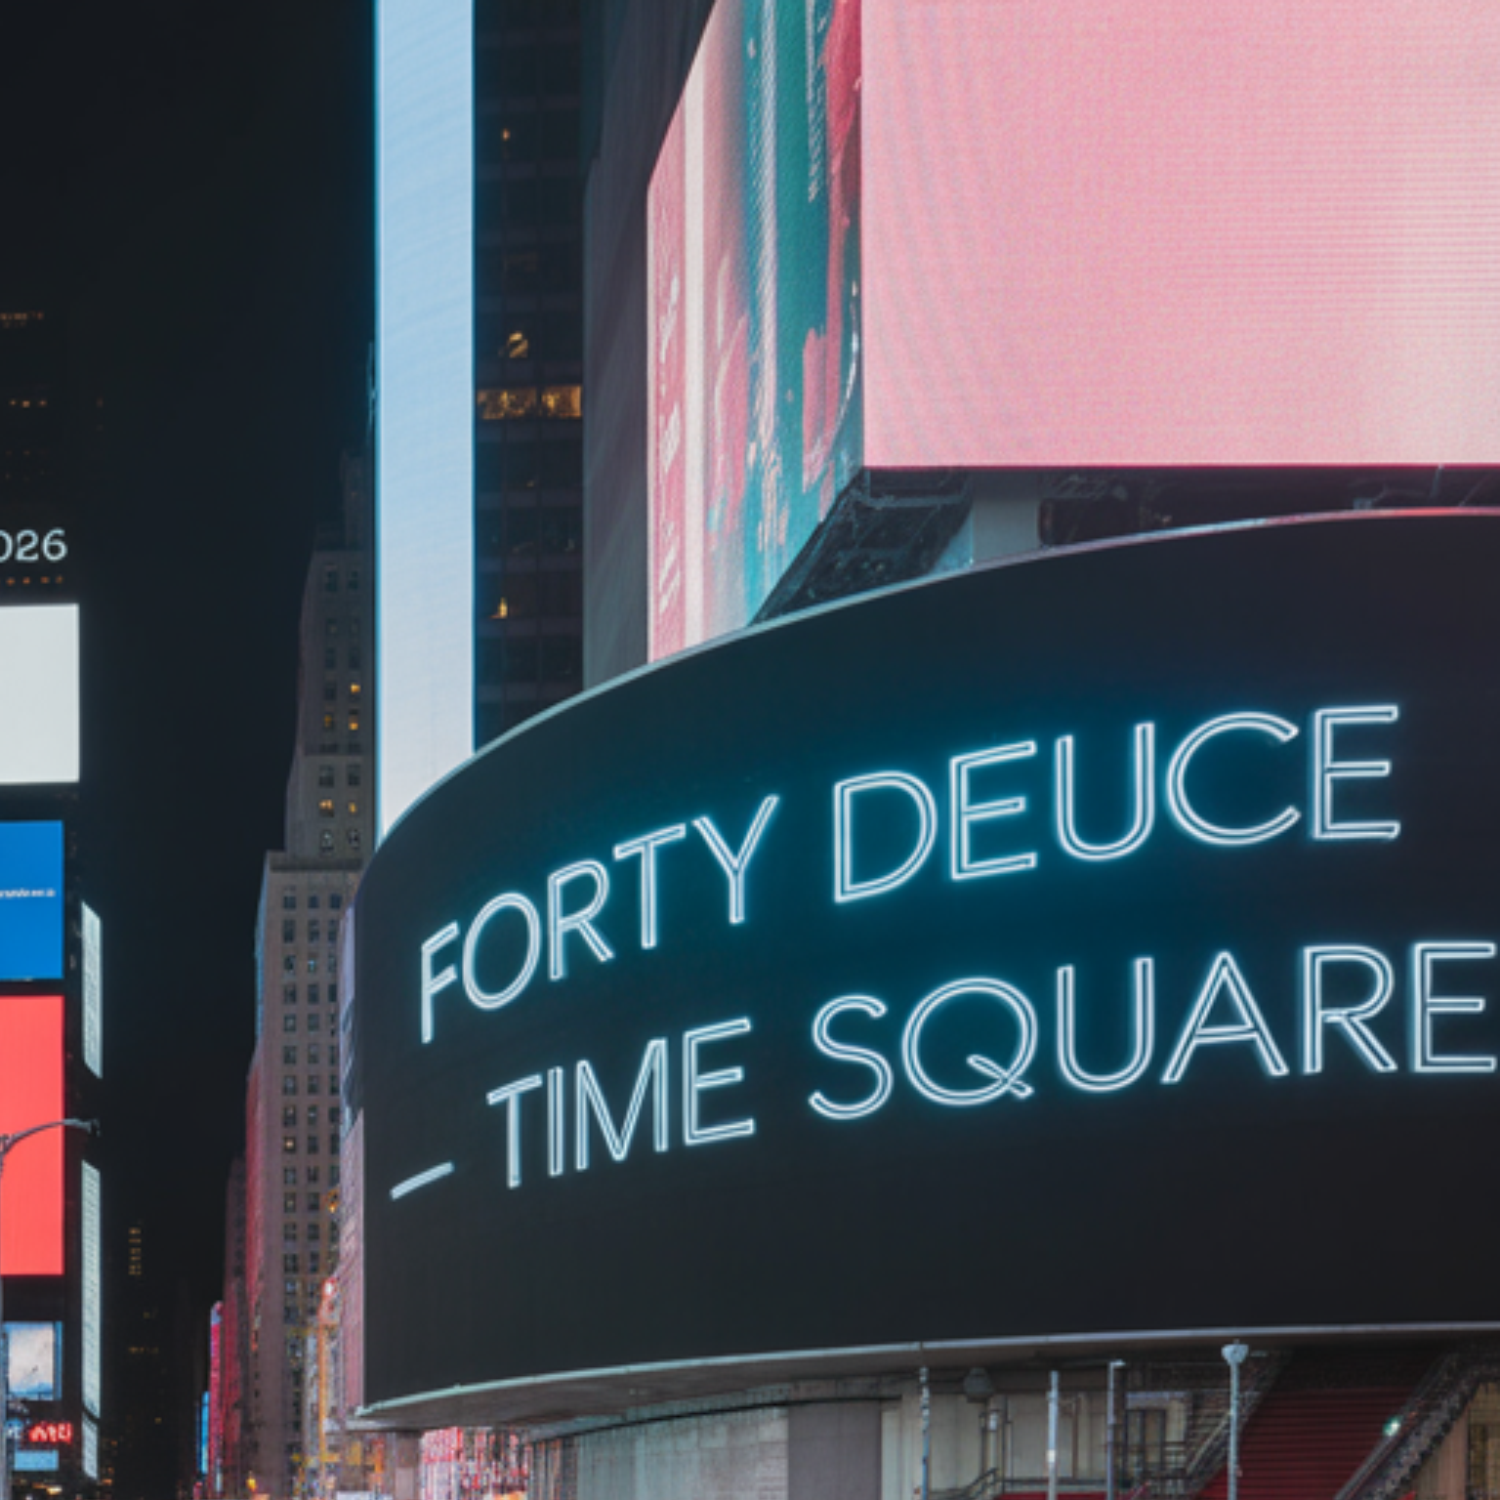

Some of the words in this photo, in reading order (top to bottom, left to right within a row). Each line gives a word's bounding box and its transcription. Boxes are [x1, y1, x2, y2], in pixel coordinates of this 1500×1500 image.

[420, 794, 781, 1045] FORTY
[833, 704, 1401, 904] DEUCE
[485, 1016, 756, 1190] TIME
[807, 941, 1498, 1121] SQUARE
